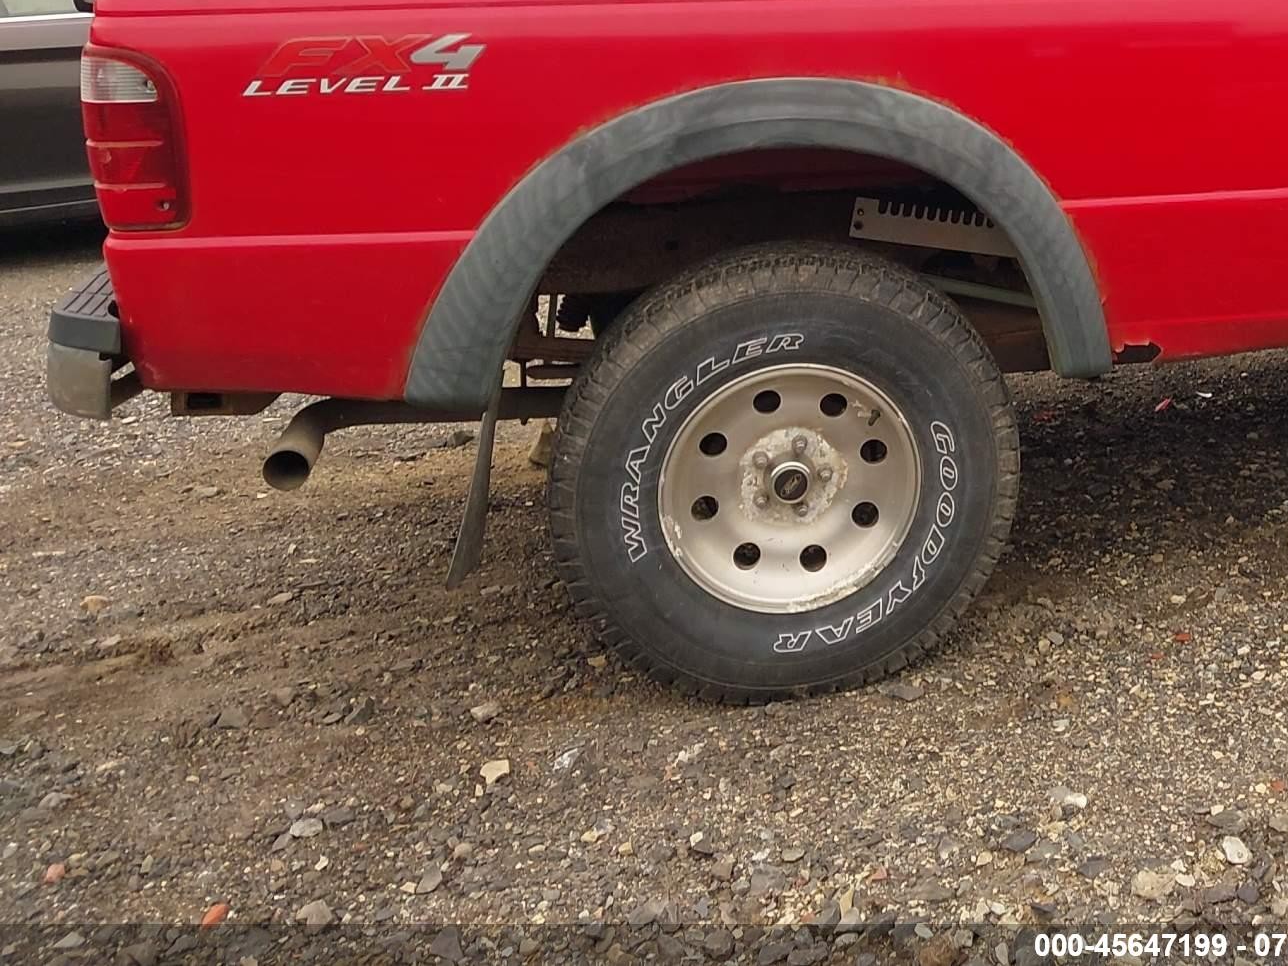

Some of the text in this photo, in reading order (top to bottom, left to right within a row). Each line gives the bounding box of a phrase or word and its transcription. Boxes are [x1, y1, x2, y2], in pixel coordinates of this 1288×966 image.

[242, 73, 470, 97] LEVEL II
[256, 32, 488, 77] FX4
[620, 333, 805, 563] WRANGLER
[772, 420, 959, 654] GOODYEAR
